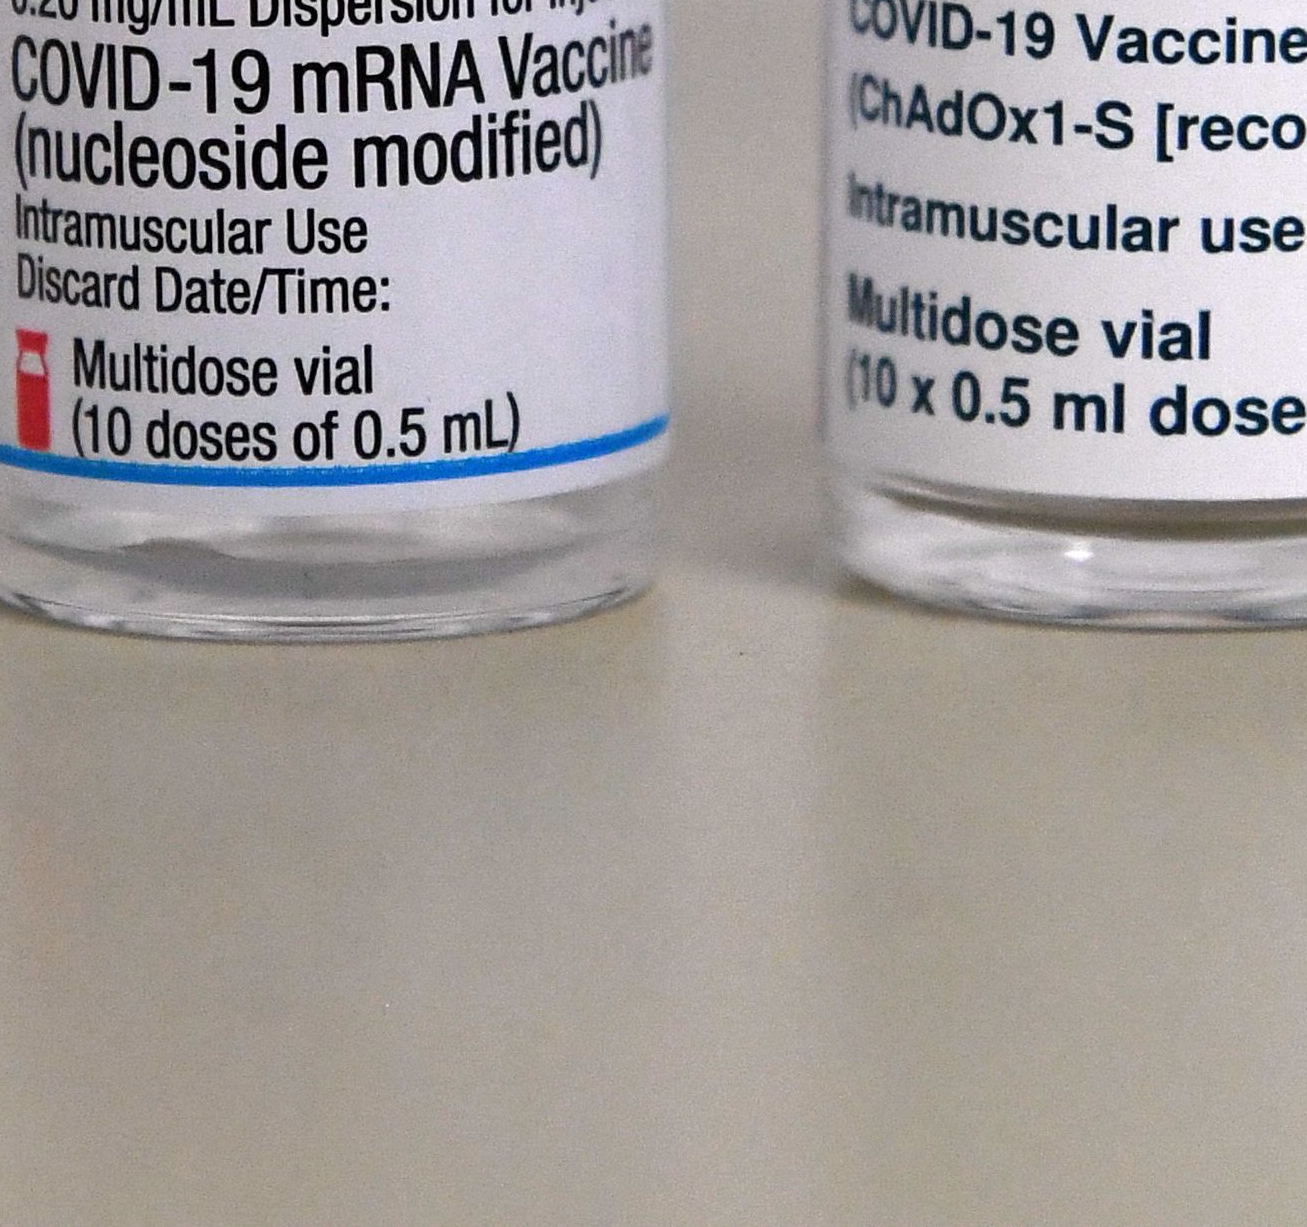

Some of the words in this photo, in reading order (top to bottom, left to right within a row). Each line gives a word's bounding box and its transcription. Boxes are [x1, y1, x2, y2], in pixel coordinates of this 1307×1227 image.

[10, 34, 272, 117] COVID-19
[294, 38, 486, 112] mRNA
[497, 17, 654, 101] Vaccine
[14, 110, 330, 191] (nucleoside
[353, 98, 603, 187] modified)
[850, 72, 1134, 151] (ChAdOx1-S
[14, 194, 274, 256] Intramuscular
[286, 207, 370, 257] Use
[848, 172, 1180, 254] Intramuscular
[1199, 214, 1307, 255] use
[16, 254, 142, 313] Discard
[155, 267, 392, 317] Date/Time:
[848, 272, 1080, 357] Multidose
[1100, 310, 1211, 361] vial
[72, 337, 279, 398] Multidose
[293, 344, 375, 396] vial
[848, 347, 898, 411] (10
[910, 375, 935, 416] x
[951, 370, 1030, 427] 0.5
[1053, 384, 1125, 434] ml
[72, 396, 132, 462] (10
[146, 407, 278, 461] doses
[293, 407, 340, 462] of
[353, 409, 429, 458] 0.5
[442, 392, 524, 455] mL)
